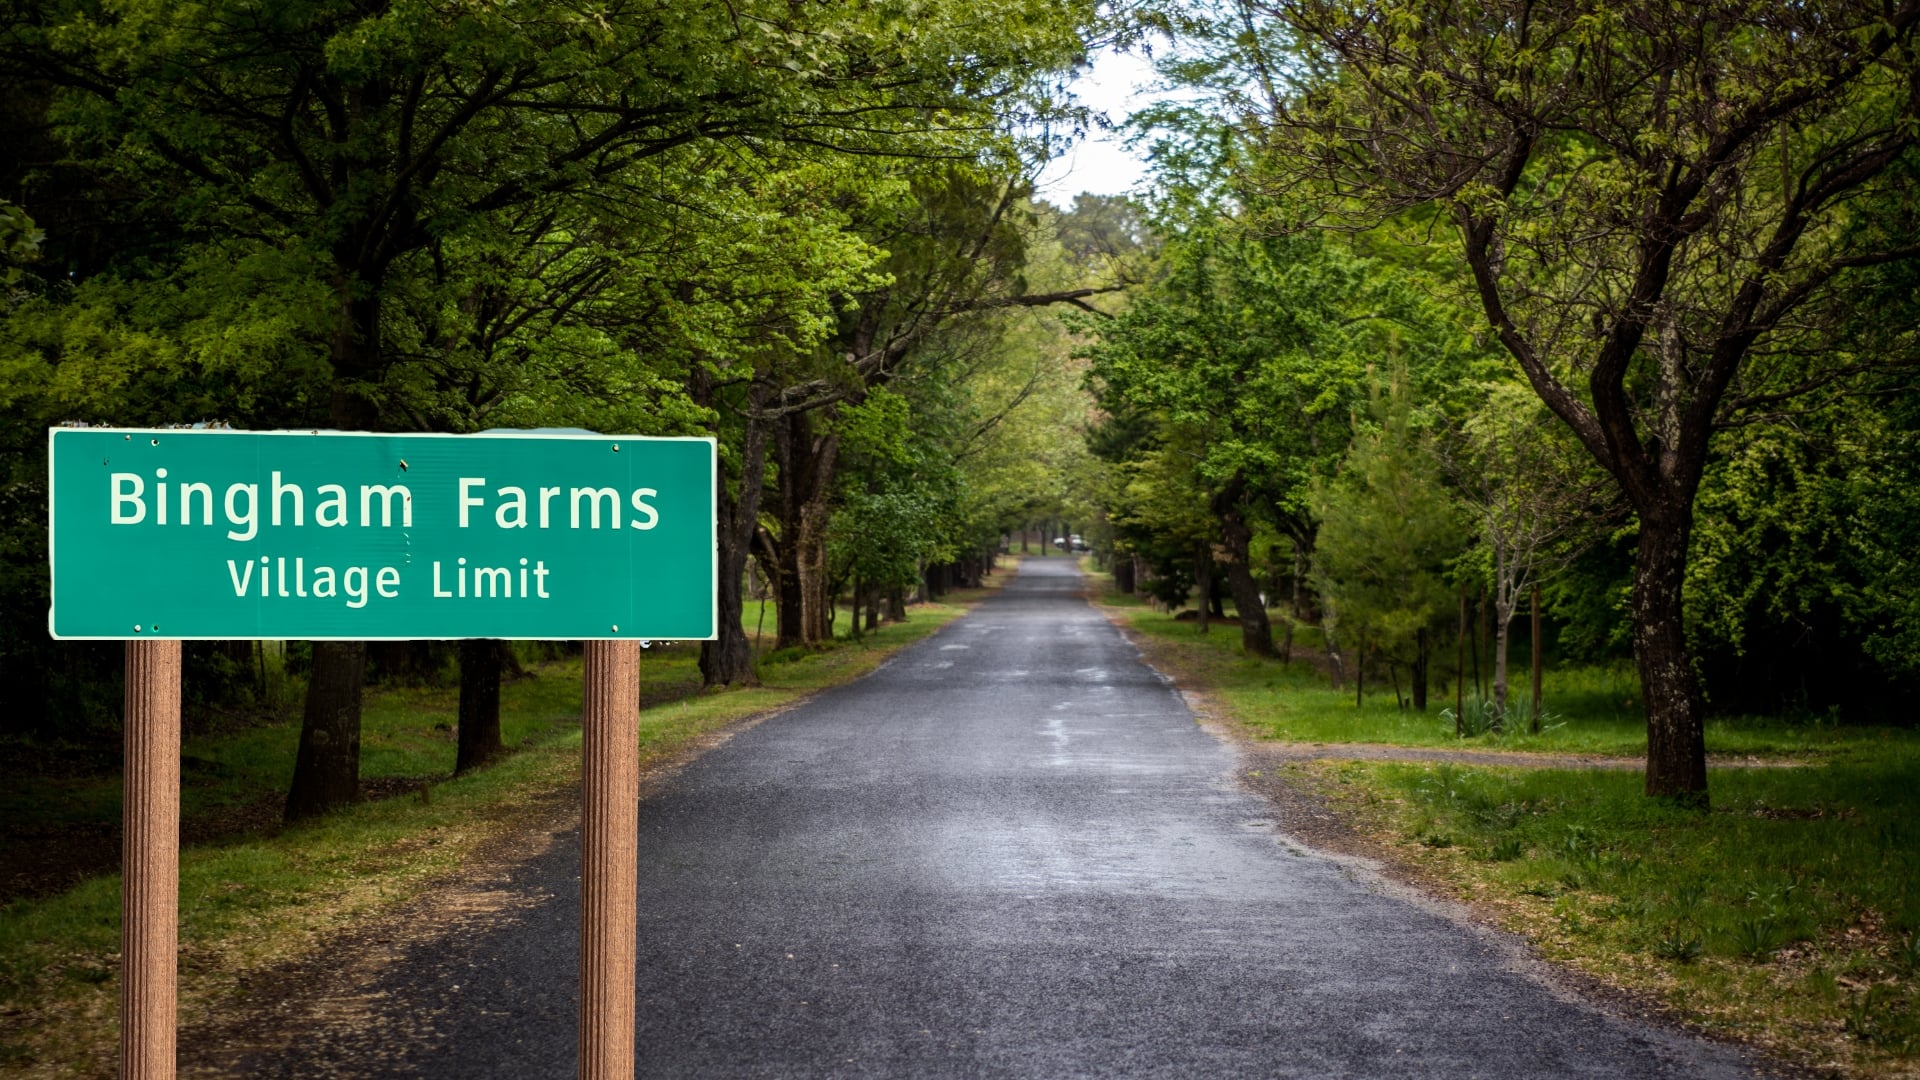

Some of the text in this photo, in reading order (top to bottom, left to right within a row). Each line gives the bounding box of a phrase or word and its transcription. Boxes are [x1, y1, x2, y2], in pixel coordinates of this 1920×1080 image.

[110, 468, 660, 542] Bingham Farms
[227, 556, 550, 609] Village Limit
